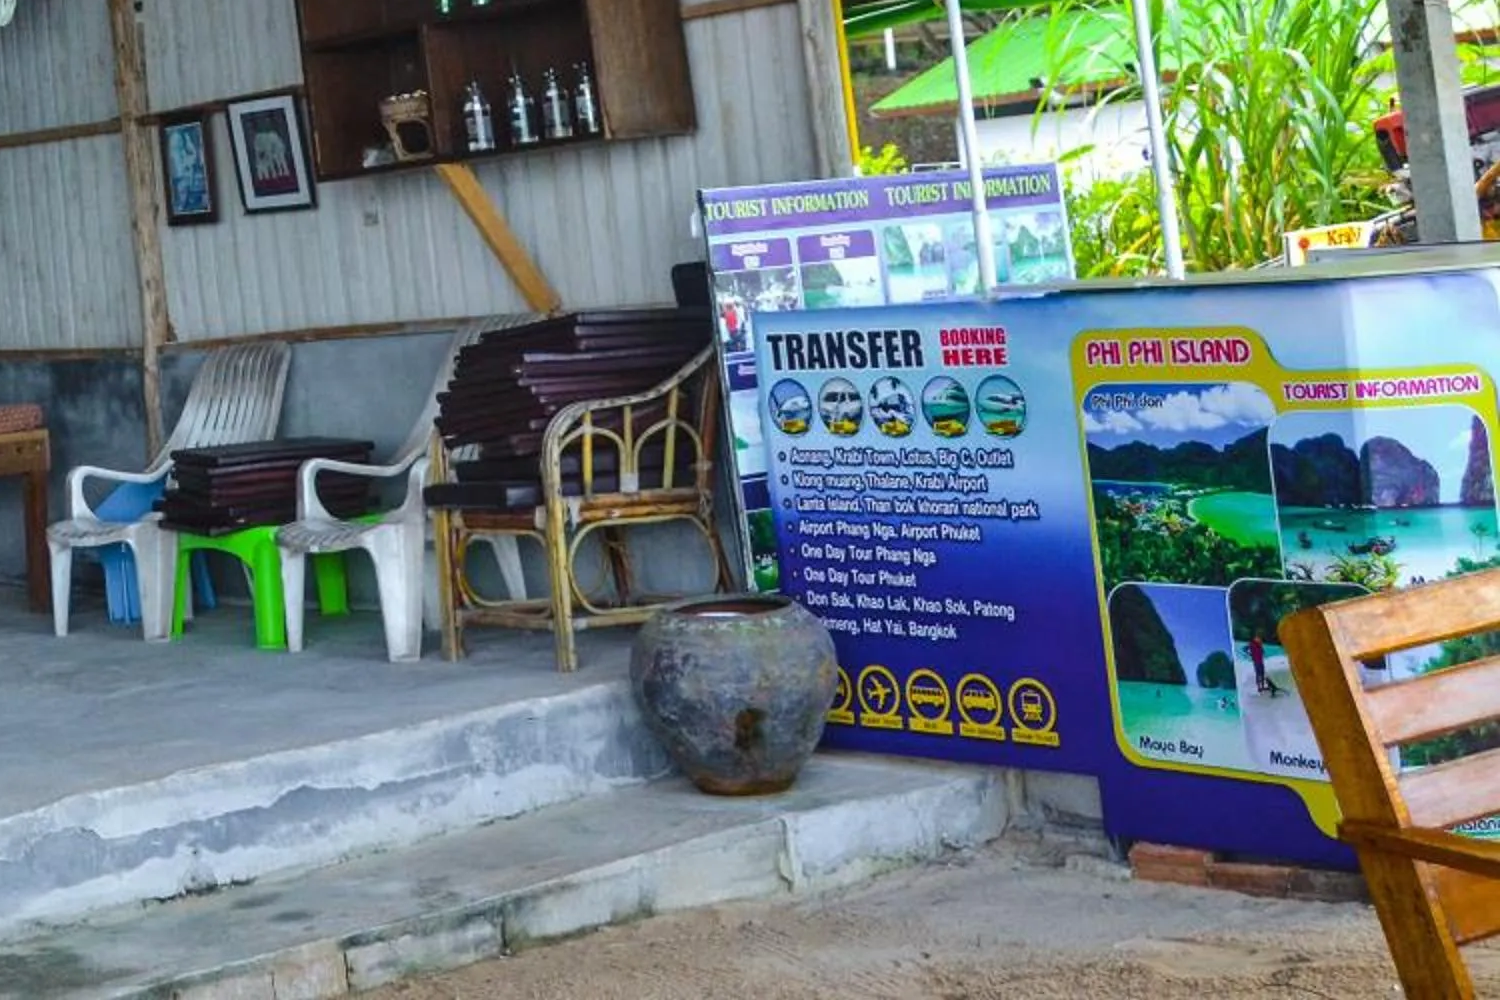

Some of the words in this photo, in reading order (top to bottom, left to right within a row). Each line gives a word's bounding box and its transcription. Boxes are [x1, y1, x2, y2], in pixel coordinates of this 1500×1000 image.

[884, 182, 950, 207] TOURIST
[953, 173, 1052, 201] INRMATION
[704, 198, 768, 222] TOURIST
[771, 190, 869, 217] INFORMATION
[938, 327, 1006, 347] BOOKING
[765, 329, 925, 371] TRANSFER
[941, 347, 1009, 367] HERE
[1086, 340, 1122, 366] PHI
[1127, 339, 1164, 365] PHI
[1169, 337, 1251, 365] ISLAND
[1283, 382, 1349, 400] TOURIST
[1354, 374, 1480, 398] INFORMATION
[835, 448, 863, 466] Krabi
[865, 448, 900, 467] Town,
[939, 449, 958, 469] Big
[977, 449, 1013, 467] Outlet
[915, 472, 945, 490] Krabi
[947, 473, 987, 493] Airport
[1010, 501, 1039, 520] park
[798, 519, 834, 538] Airport
[836, 520, 871, 540] Phang
[900, 524, 938, 542] Airport
[941, 525, 981, 542] Phuket
[801, 543, 824, 559] One
[825, 544, 847, 562] Day
[848, 545, 873, 561] Tour
[875, 546, 911, 565] Phang
[913, 548, 937, 567] Nga
[803, 567, 826, 582] One
[827, 568, 850, 586] Day
[851, 569, 876, 585] Tour
[878, 570, 917, 588] Phuket
[806, 590, 829, 606] Don
[856, 593, 885, 610] Khao
[913, 596, 943, 613] Khao
[973, 600, 1016, 623] Patong
[863, 618, 883, 634] Hat
[908, 622, 958, 642] Bangkok
[1179, 739, 1205, 759] Bay
